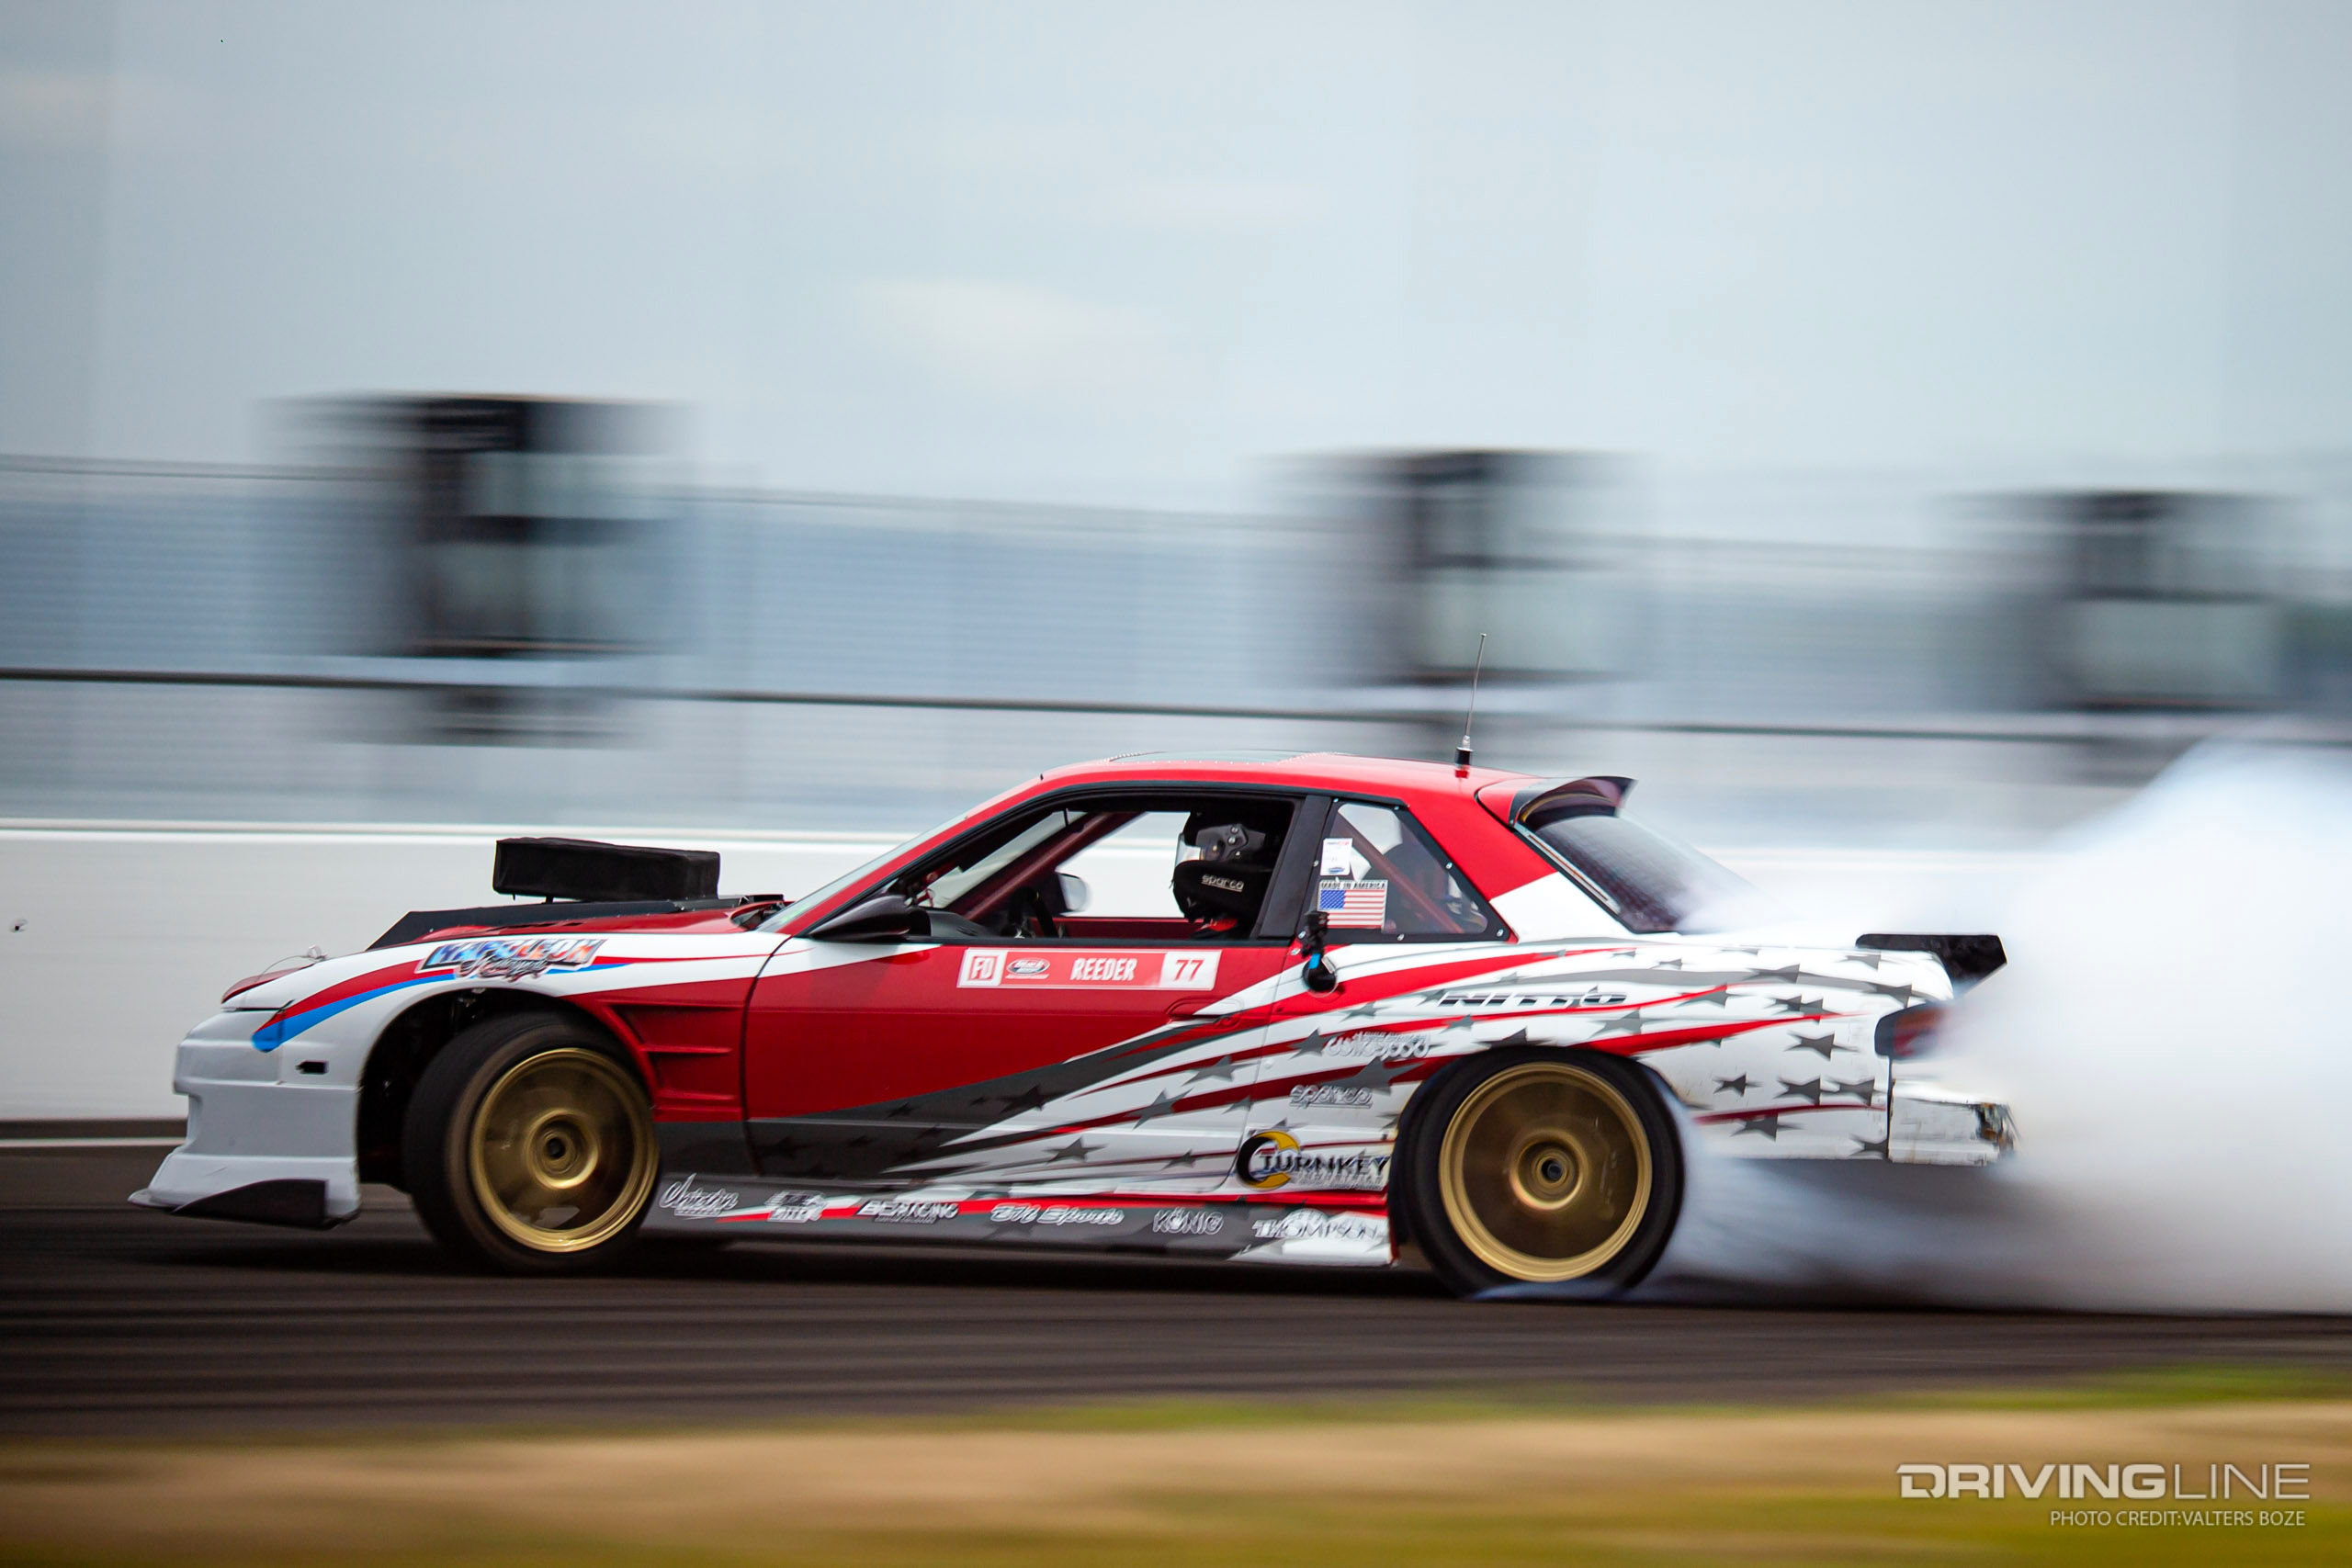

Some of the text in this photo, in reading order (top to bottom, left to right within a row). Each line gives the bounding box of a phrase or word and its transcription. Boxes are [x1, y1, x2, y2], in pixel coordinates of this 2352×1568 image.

[1201, 874, 1244, 892] sparco
[1353, 882, 1385, 890] AMERICA
[1069, 958, 1138, 981] REEDER
[1174, 959, 1205, 981] 77
[1260, 1154, 1390, 1173] TURNKEY
